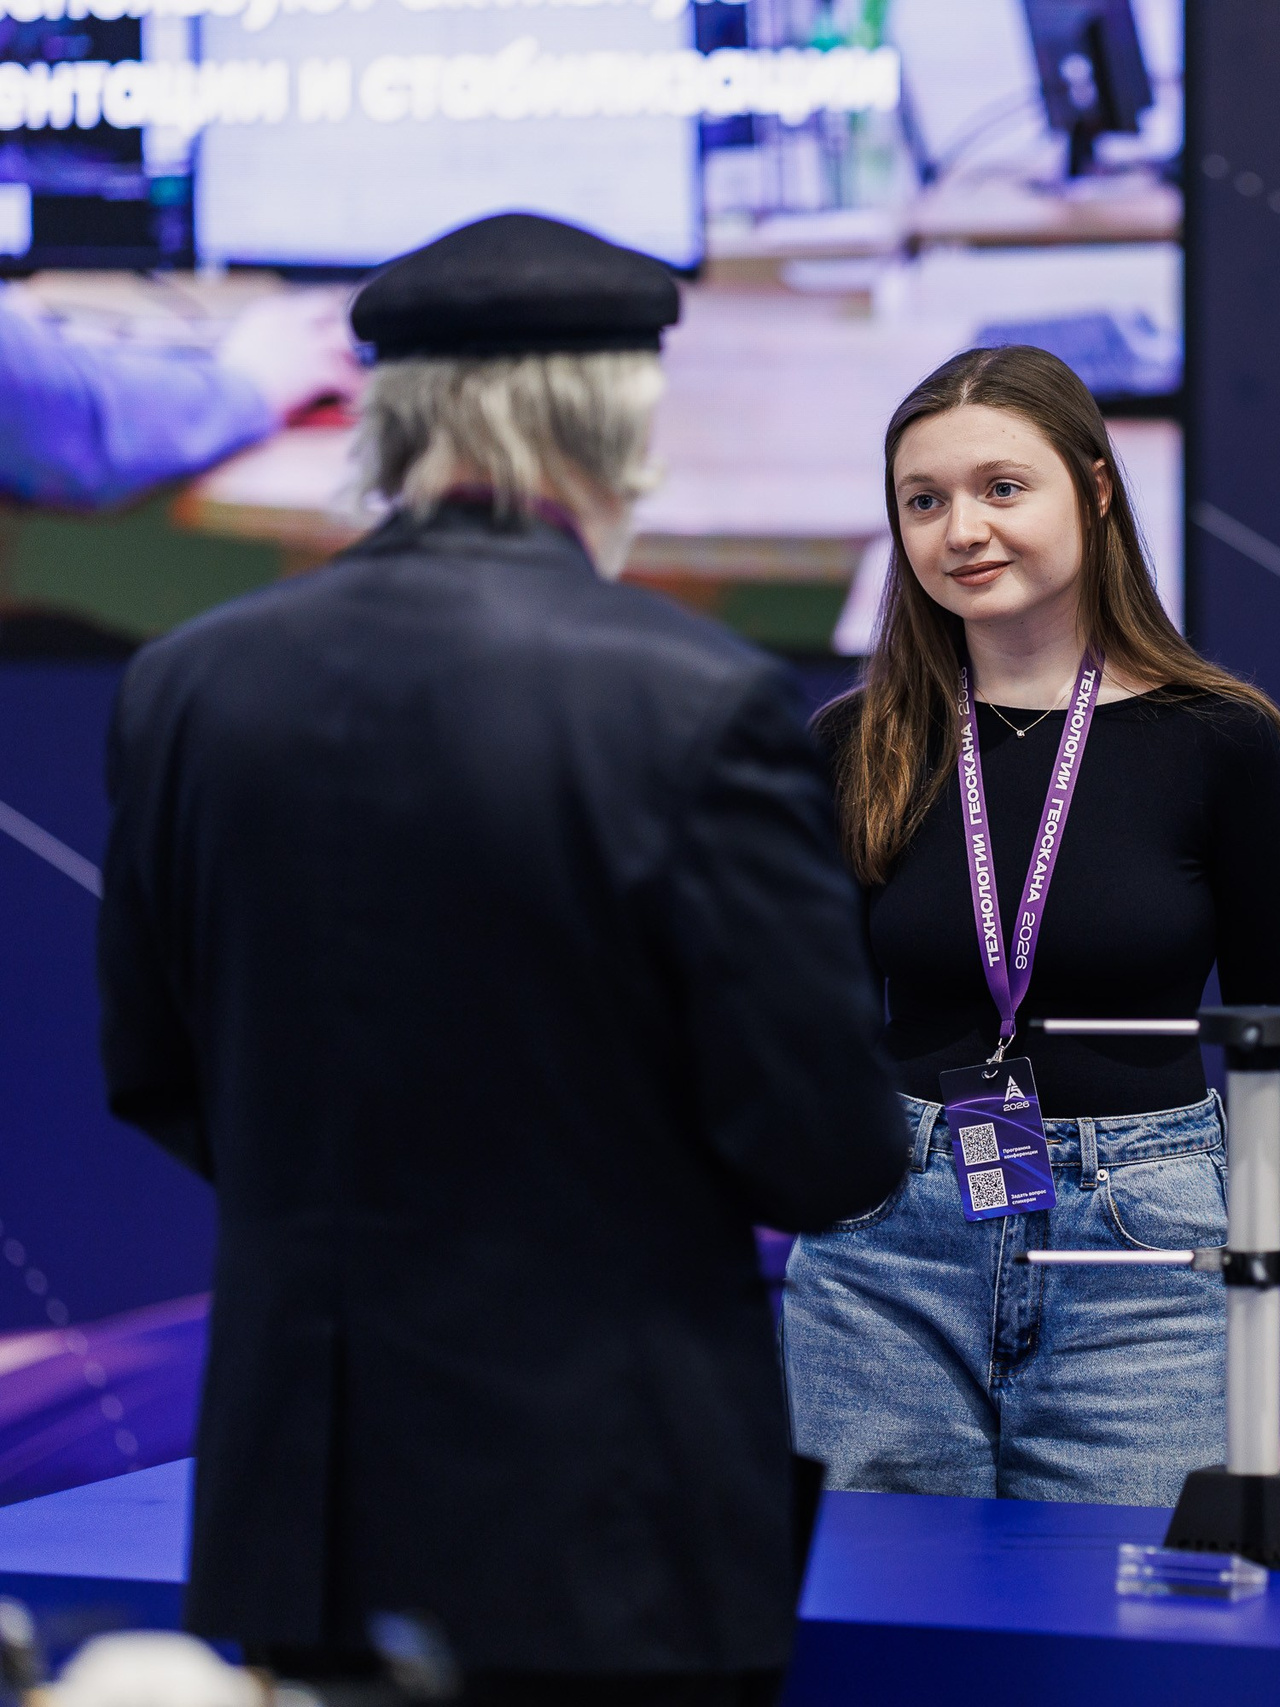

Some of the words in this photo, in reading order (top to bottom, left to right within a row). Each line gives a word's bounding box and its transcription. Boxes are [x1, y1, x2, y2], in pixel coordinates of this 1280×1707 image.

[961, 722, 983, 825] ГЕОСКАНА
[1055, 669, 1096, 791] ТЕХНОЛОГИИ
[972, 834, 1000, 967] ТЕХНОЛОГИИ
[1027, 798, 1065, 903] ГЕОСКАНА
[1015, 911, 1036, 970] 2026
[1003, 1100, 1030, 1112] 2026
